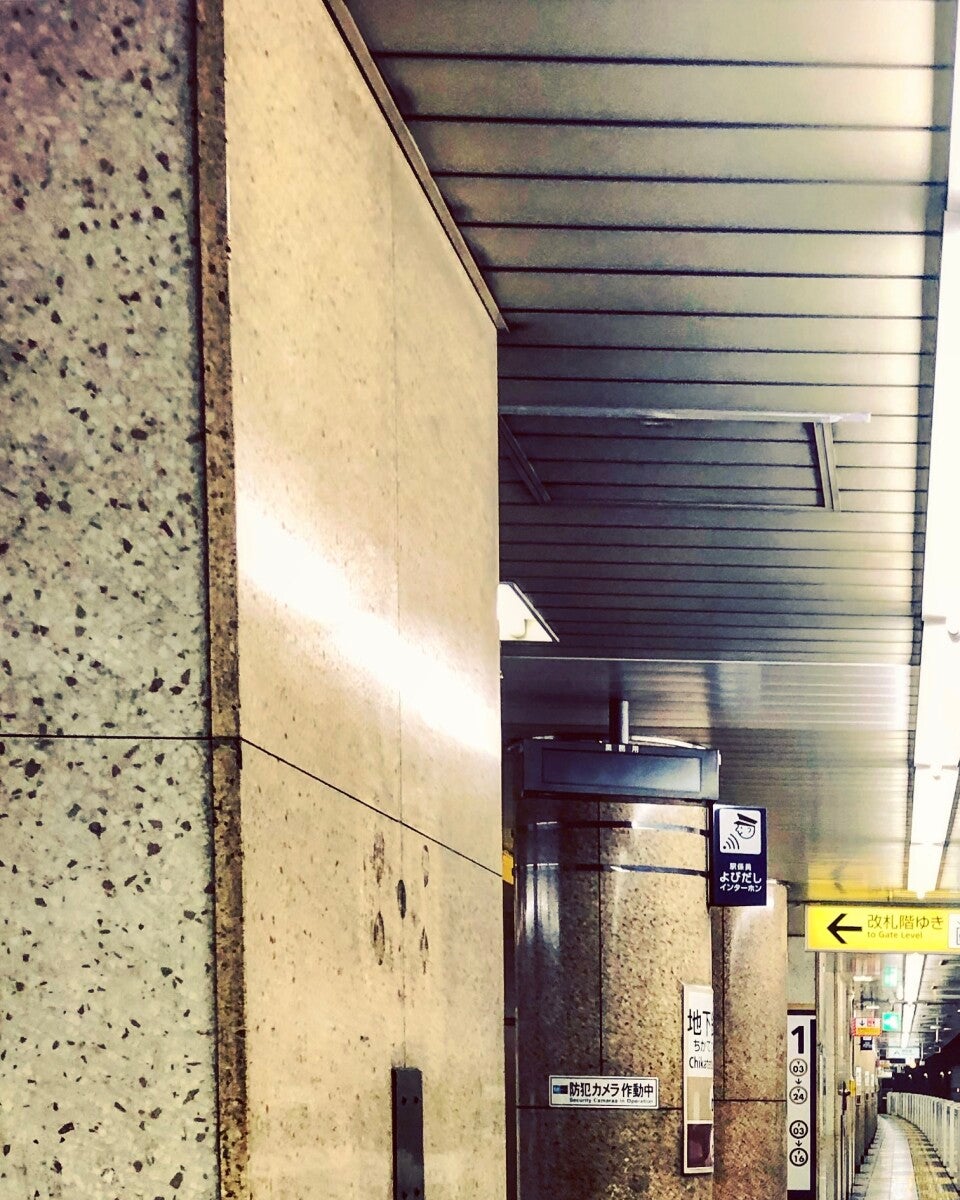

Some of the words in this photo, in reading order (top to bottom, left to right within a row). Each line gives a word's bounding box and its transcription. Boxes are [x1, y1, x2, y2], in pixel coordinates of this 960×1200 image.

[719, 871, 762, 884] よびだし
[719, 883, 762, 893] インターホン
[867, 914, 944, 930] 改札階ゆき
[878, 931, 899, 939] Gate
[790, 1025, 805, 1054] 1
[792, 1065, 805, 1073] 03
[569, 1081, 654, 1098] 防犯カメラ作動中
[793, 1093, 805, 1101] 24
[793, 1127, 805, 1135] 03
[793, 1155, 805, 1163] 16
